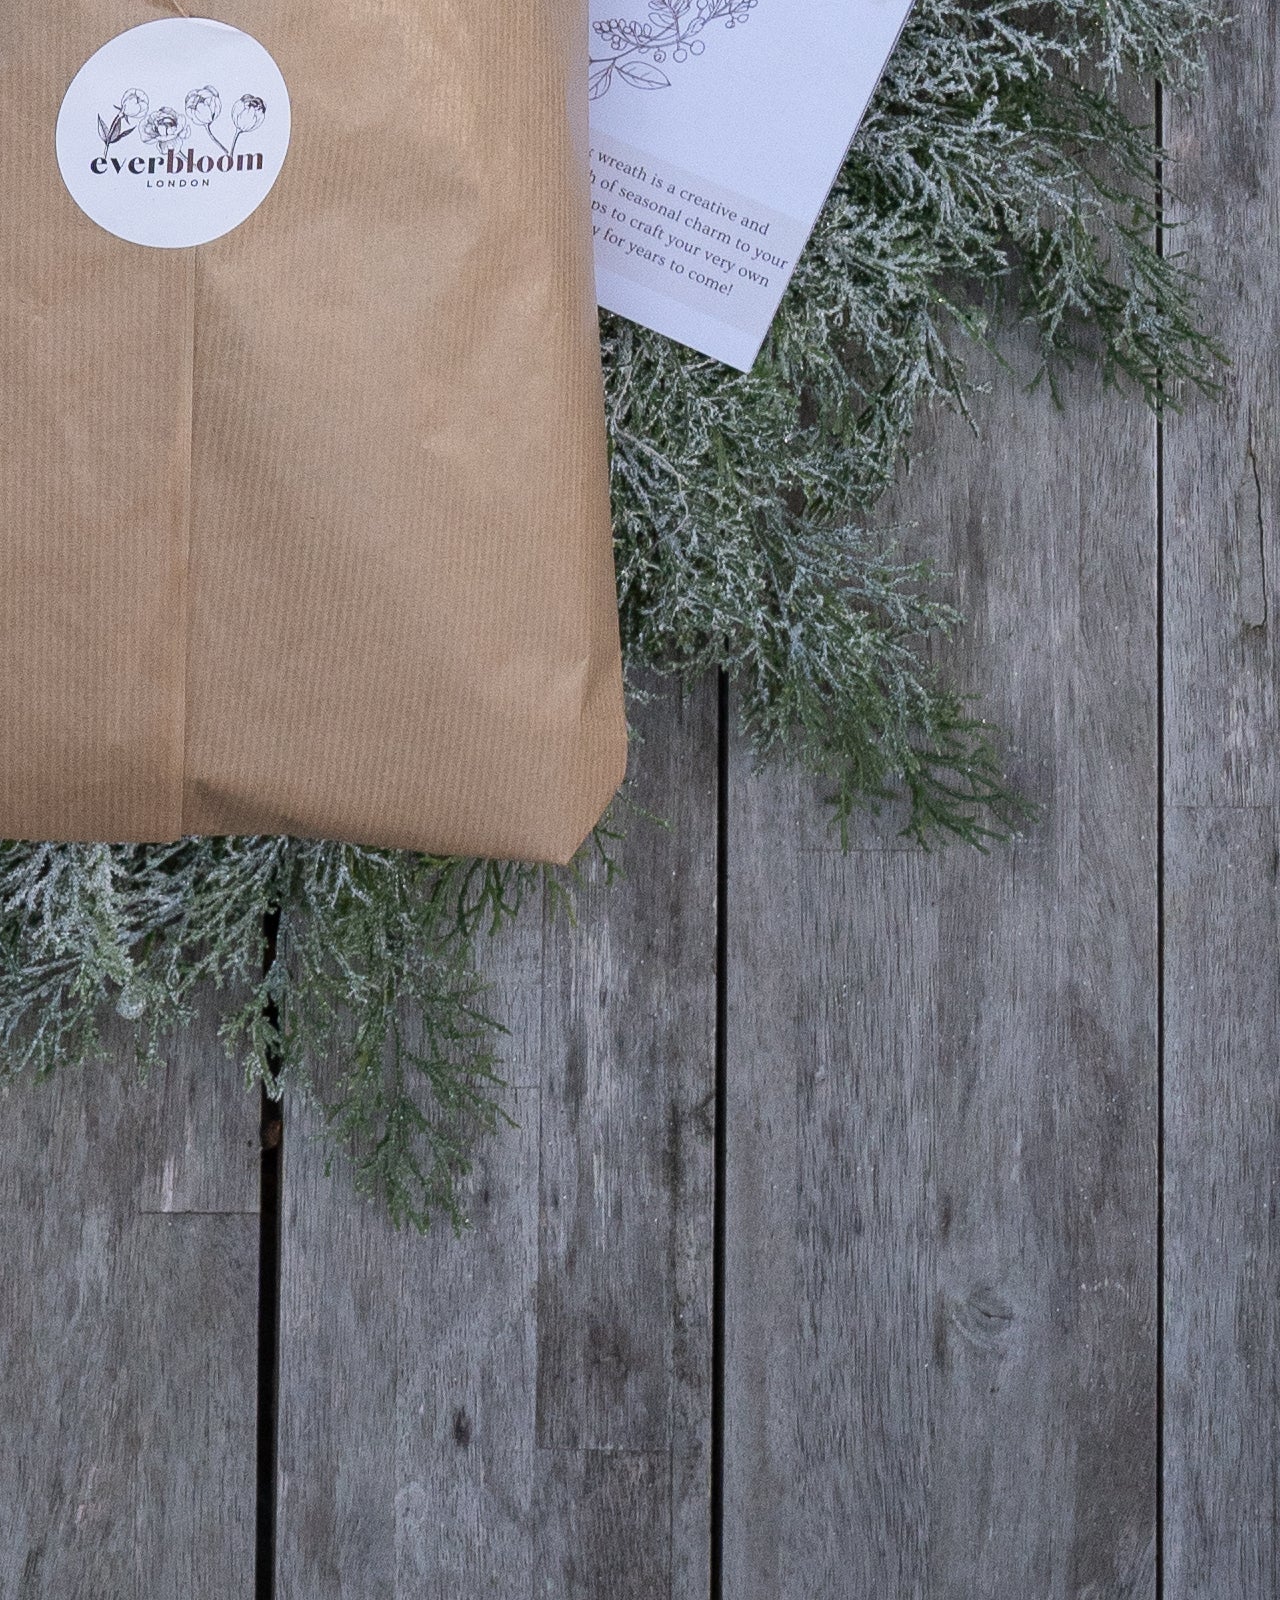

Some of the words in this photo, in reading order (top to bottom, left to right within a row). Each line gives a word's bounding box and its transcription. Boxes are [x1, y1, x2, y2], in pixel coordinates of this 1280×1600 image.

[90, 148, 264, 175] everbloom
[146, 179, 210, 188] LONDON
[598, 151, 647, 182] wreath
[651, 173, 664, 188] is
[667, 183, 676, 195] a
[680, 189, 737, 221] creative
[740, 216, 770, 236] and
[600, 179, 619, 192] of
[618, 187, 682, 222] seasonal
[684, 217, 731, 244] charm
[735, 238, 751, 253] to
[751, 247, 789, 270] your
[603, 227, 626, 247] for
[625, 241, 666, 266] years
[669, 260, 685, 274] to
[688, 269, 734, 296] come!
[611, 208, 626, 223] to
[629, 218, 665, 240] craft
[665, 234, 702, 256] your
[705, 250, 736, 274] very
[738, 267, 770, 287] own
